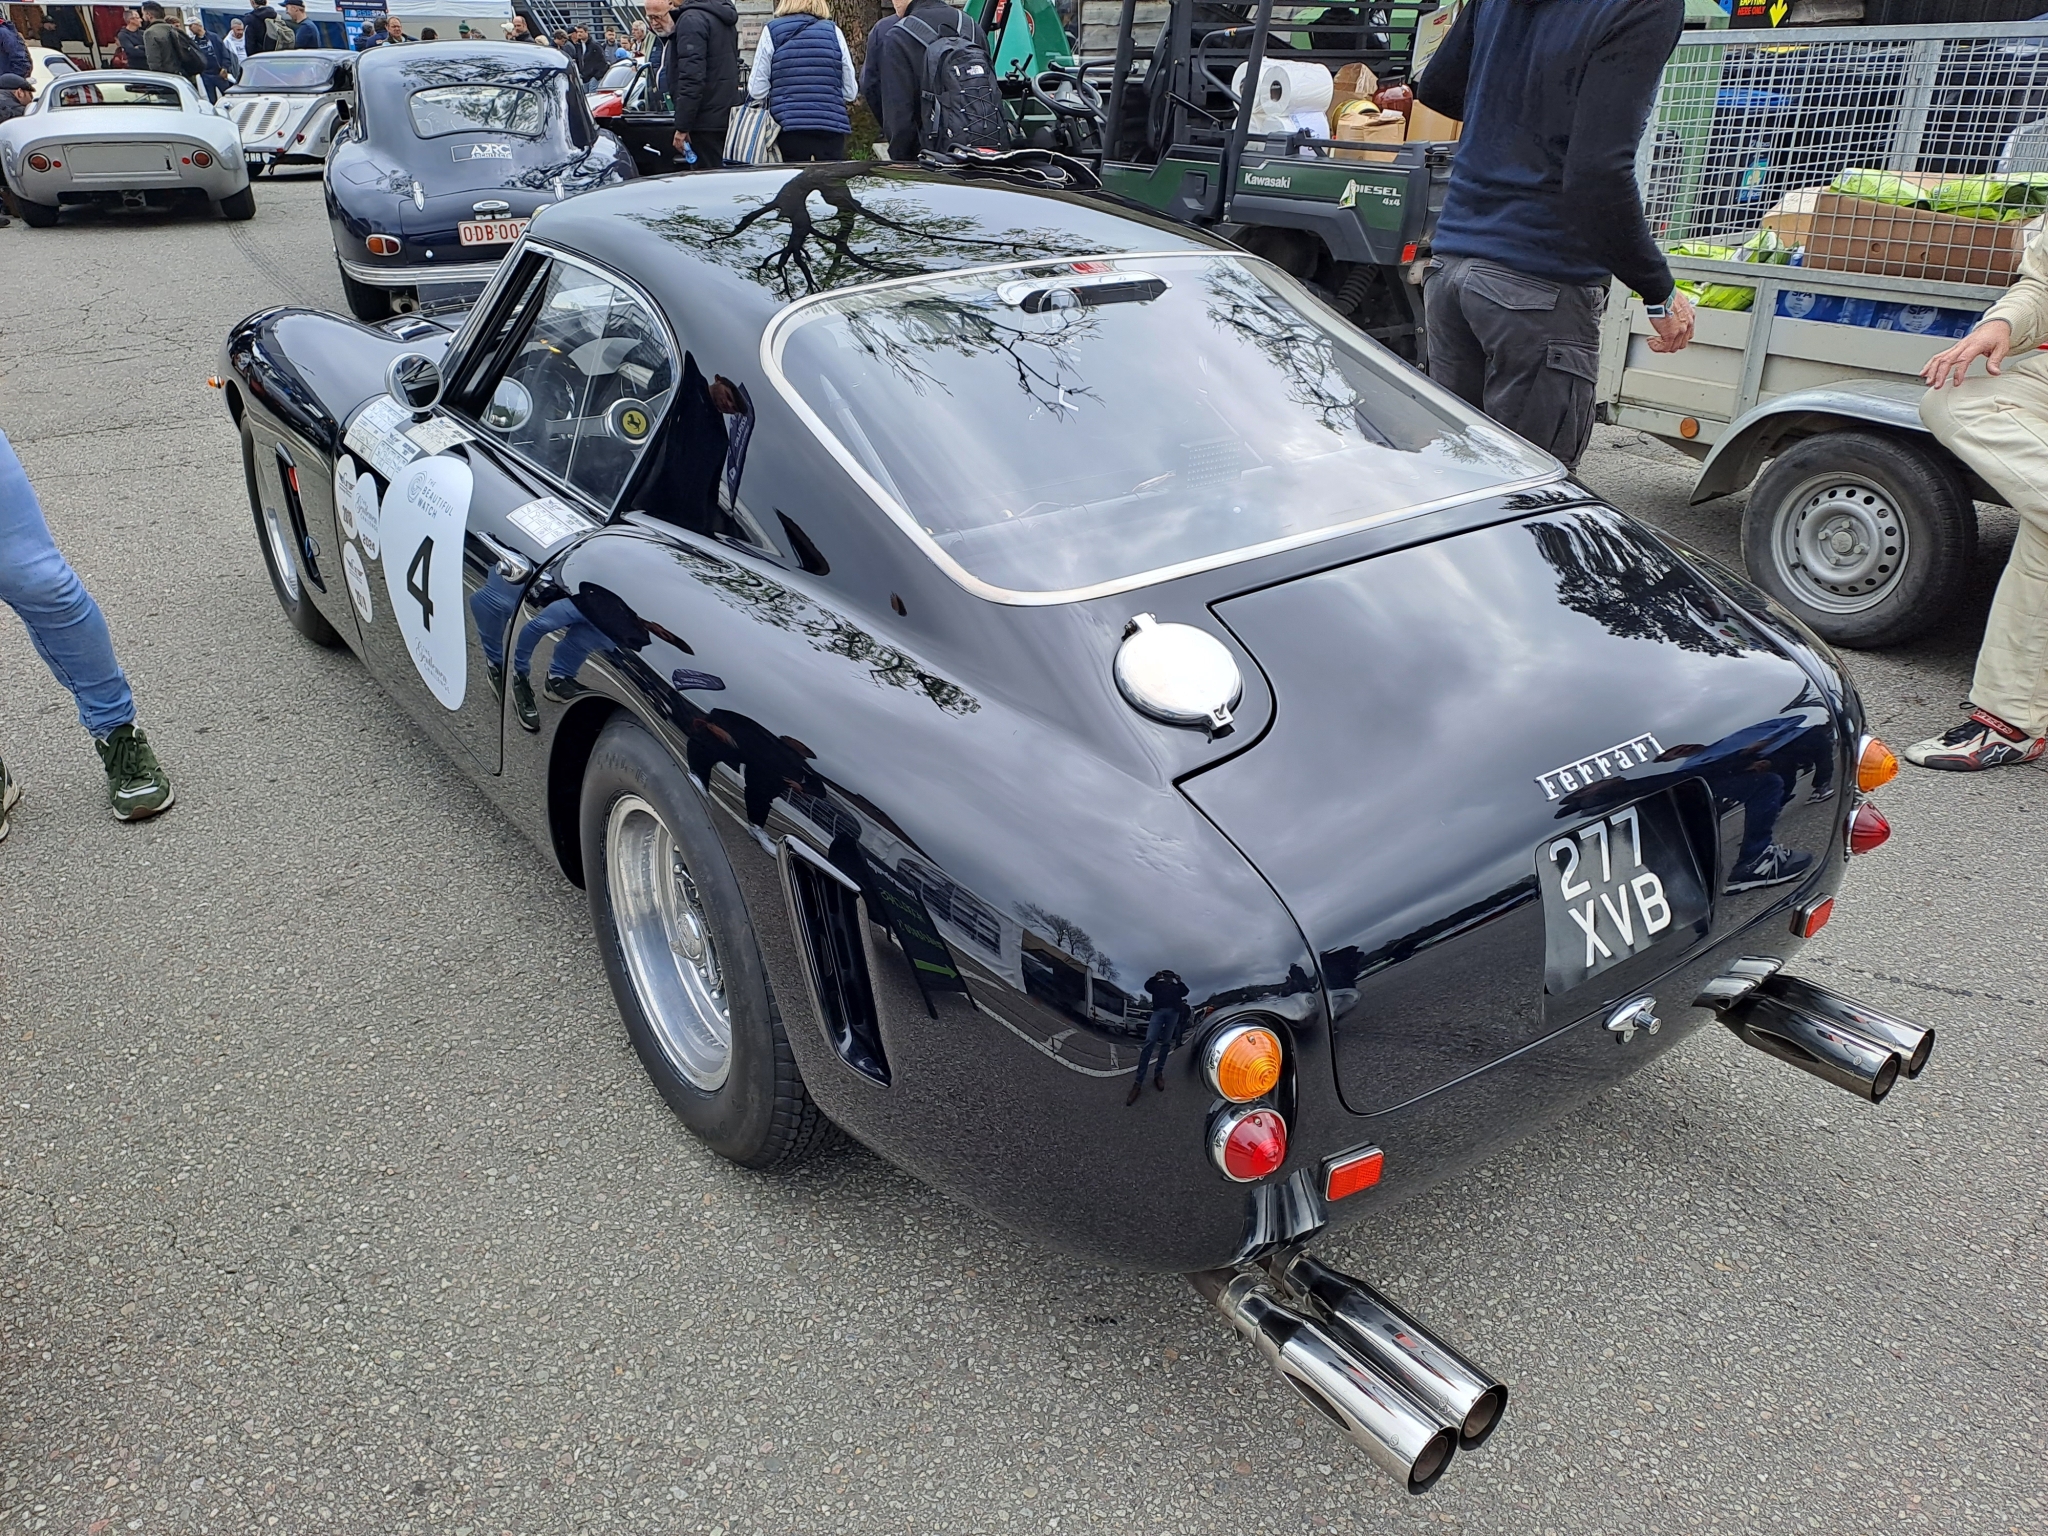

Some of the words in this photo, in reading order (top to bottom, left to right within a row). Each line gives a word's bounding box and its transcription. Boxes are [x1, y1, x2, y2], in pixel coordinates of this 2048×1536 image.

[1737, 6, 1751, 15] HERE
[1752, 6, 1766, 15] ONLY
[1244, 172, 1291, 189] Kawasaki
[1353, 184, 1402, 197] DIESEL
[1382, 197, 1401, 207] 4x4
[416, 496, 438, 519] WATCH
[421, 485, 454, 517] BEAUTIFUL
[406, 534, 435, 633] 4
[1535, 732, 1666, 801] Ferrari
[1549, 805, 1643, 902] 277
[1567, 872, 1672, 968] XVB
